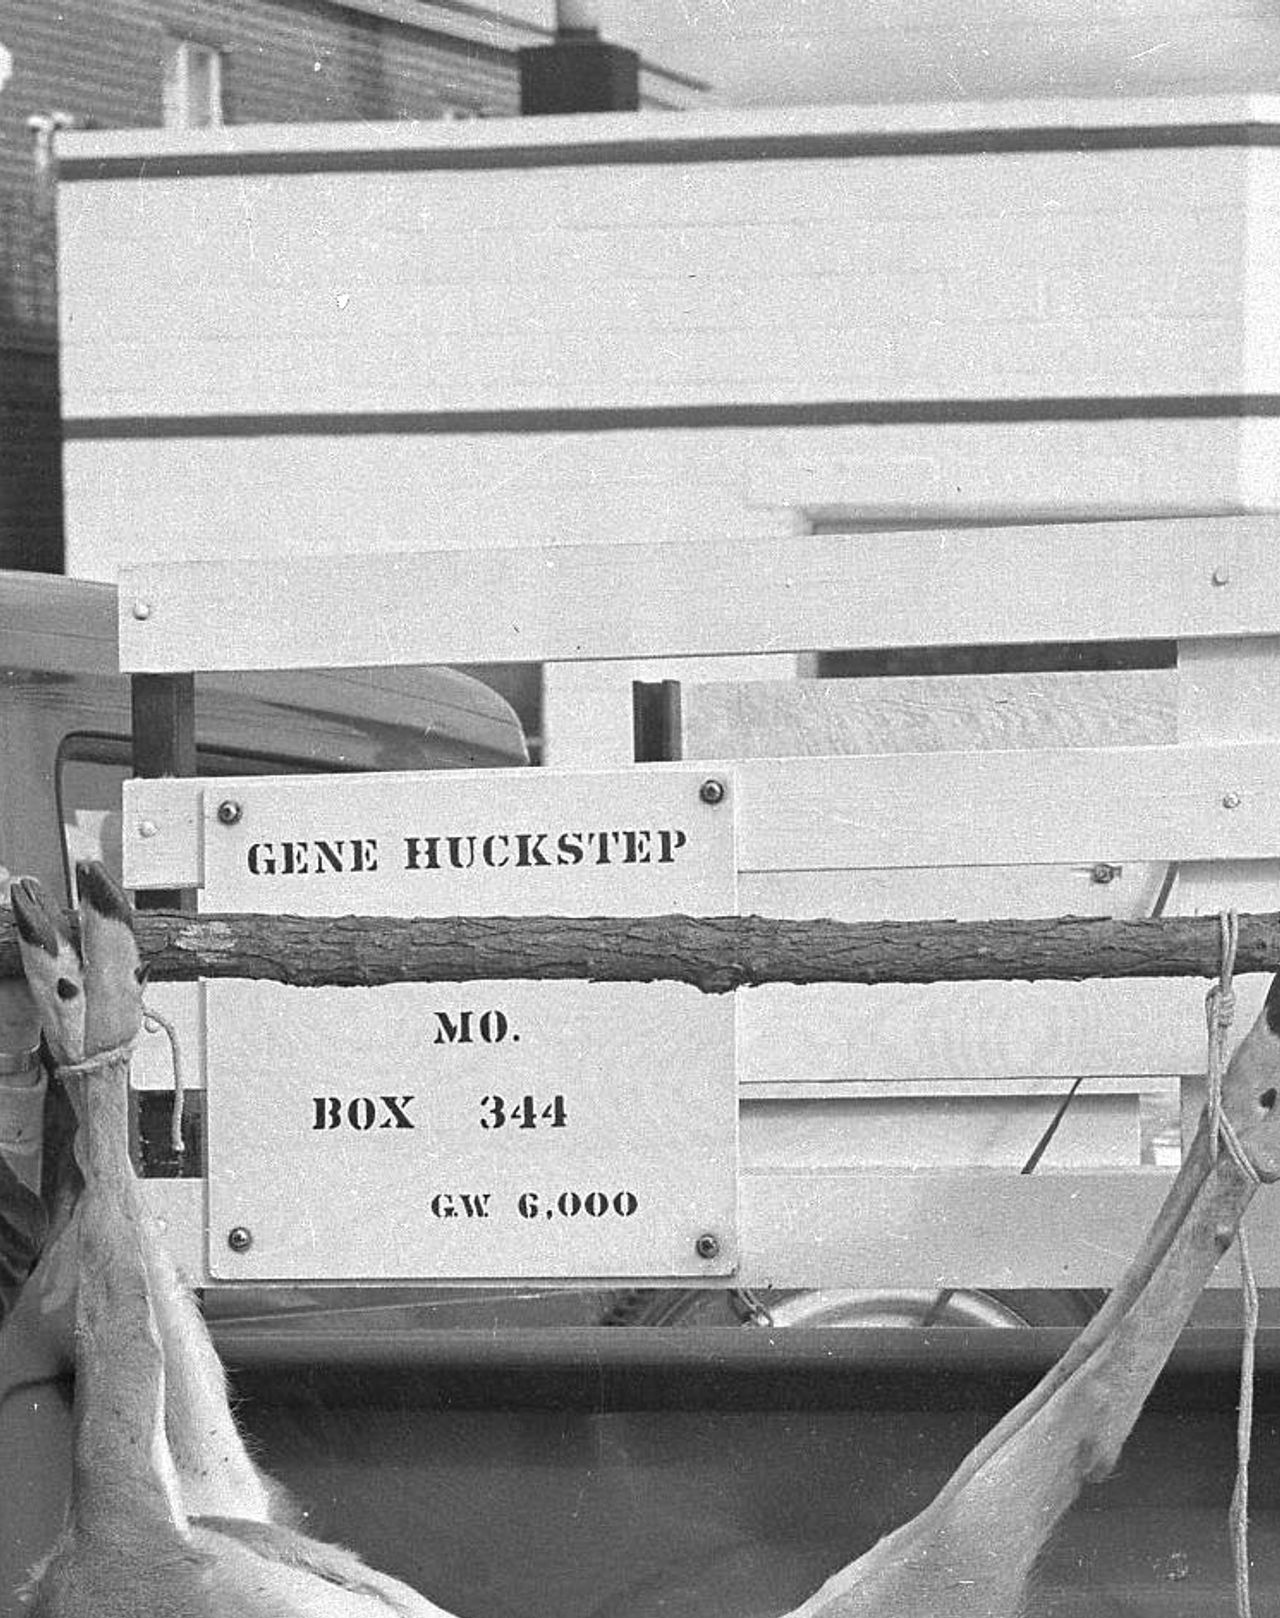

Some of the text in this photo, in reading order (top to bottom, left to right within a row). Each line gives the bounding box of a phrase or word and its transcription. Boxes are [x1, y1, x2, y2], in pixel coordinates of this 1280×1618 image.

[246, 829, 687, 876] GENE HUCKSTEP
[432, 1009, 521, 1045] MO.
[311, 1094, 569, 1131] BOX 344
[517, 1191, 639, 1221] 6,000
